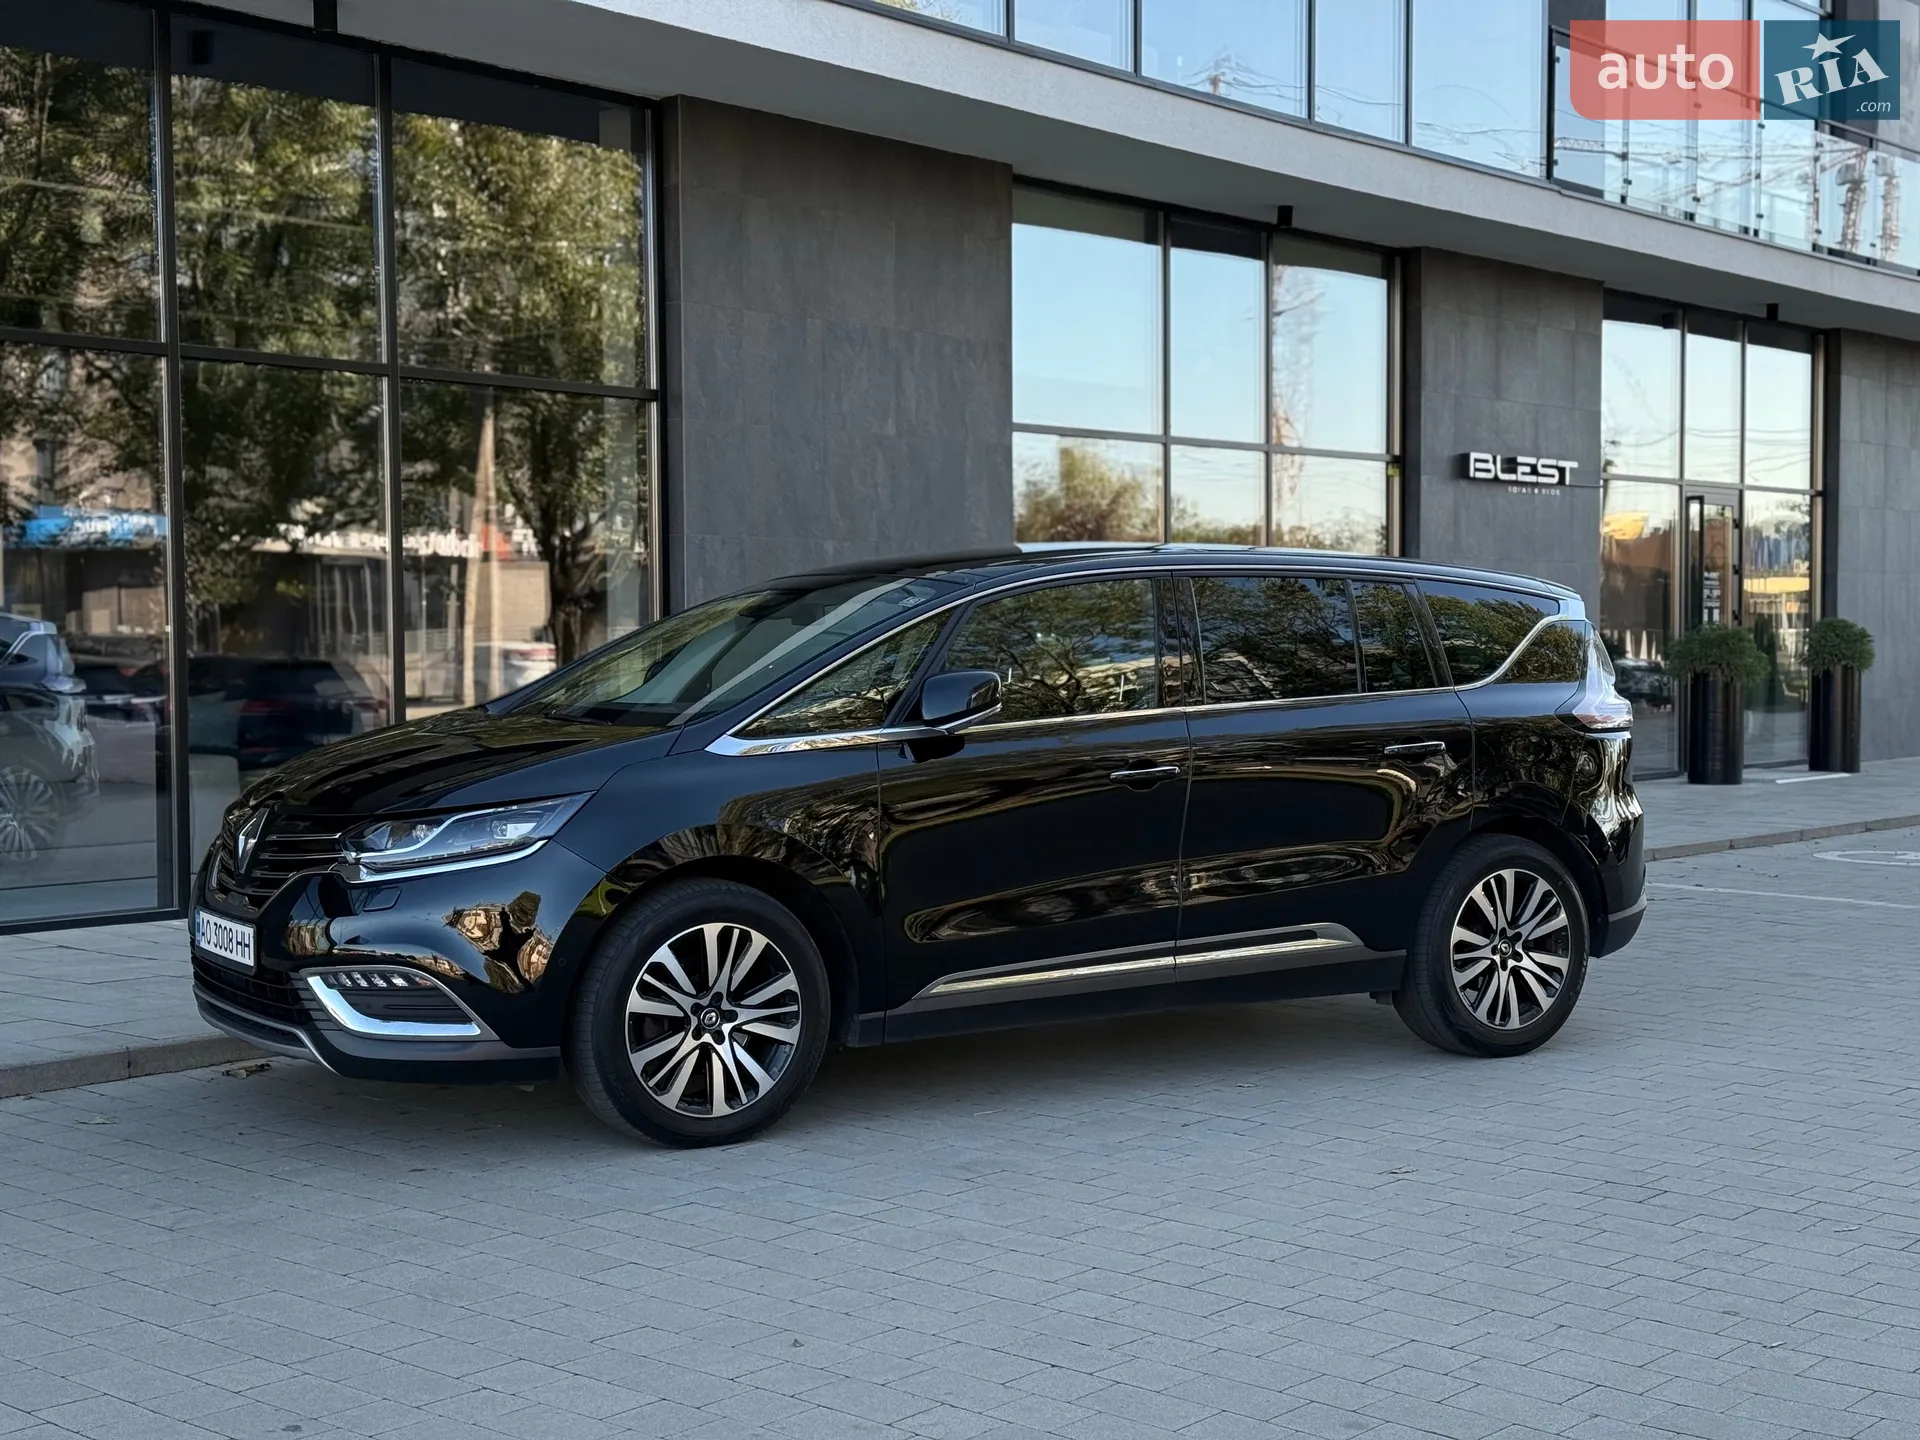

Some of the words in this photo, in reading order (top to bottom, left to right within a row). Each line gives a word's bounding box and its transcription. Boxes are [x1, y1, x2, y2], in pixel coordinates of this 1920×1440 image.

[1469, 452, 1579, 485] BLEST
[213, 922, 234, 954] 3008
[235, 929, 251, 960] HH
